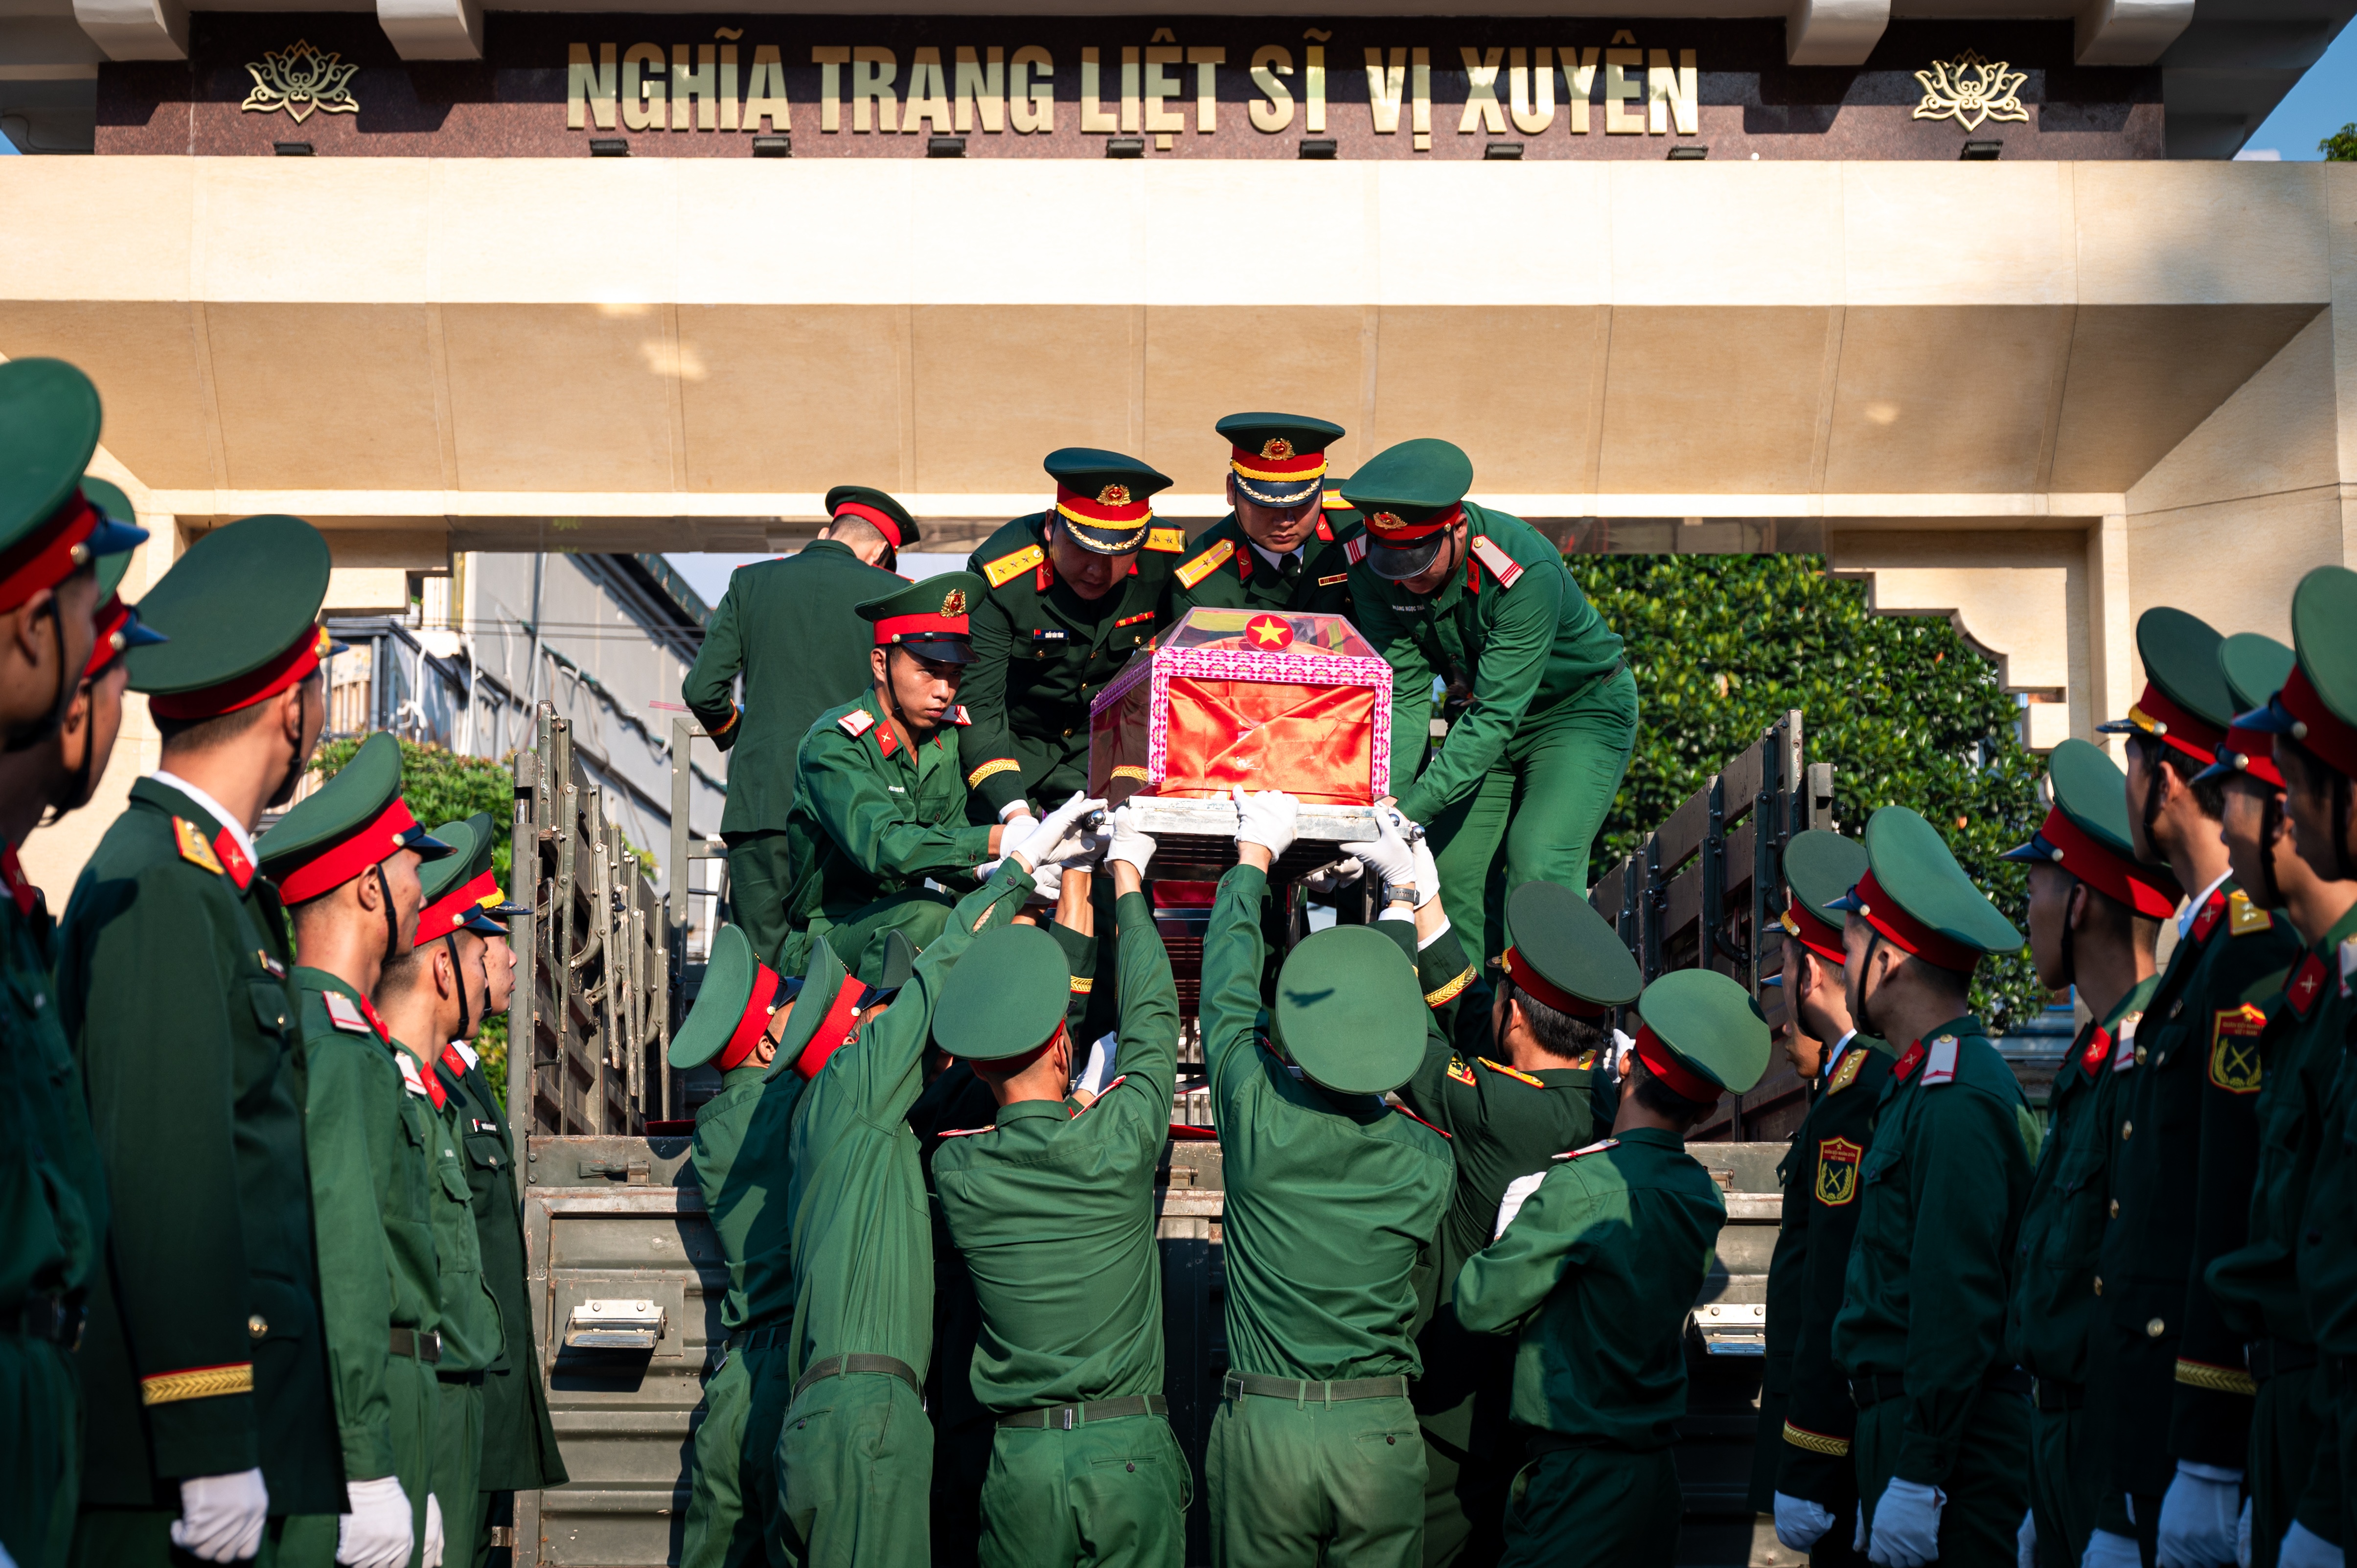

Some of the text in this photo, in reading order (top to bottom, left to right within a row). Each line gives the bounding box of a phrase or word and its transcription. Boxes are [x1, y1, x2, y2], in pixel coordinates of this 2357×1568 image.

[567, 26, 1699, 151] NGHĨA TRANG LIỆT SĨ VỊ XUYÊN
